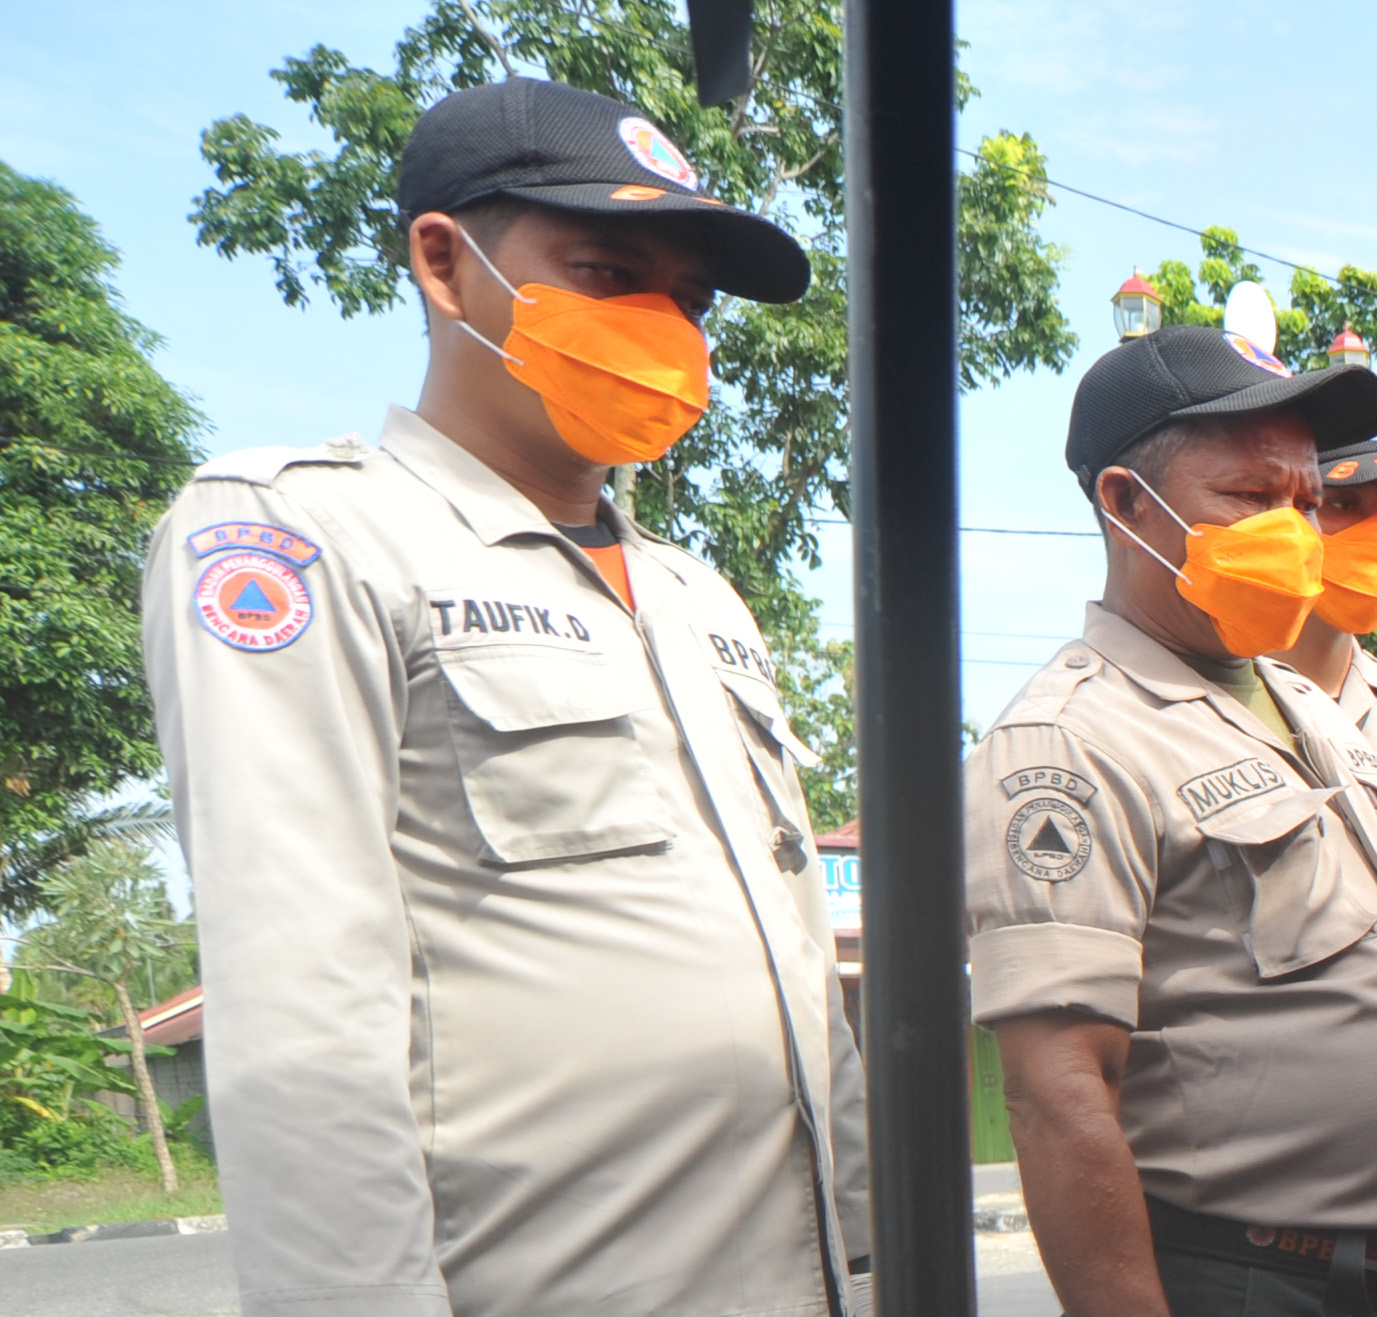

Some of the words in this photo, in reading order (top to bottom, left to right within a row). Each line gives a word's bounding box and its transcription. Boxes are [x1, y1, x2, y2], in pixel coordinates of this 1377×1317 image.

[214, 527, 295, 550] BPBD
[263, 608, 309, 646] DAERAH
[1018, 771, 1078, 791] BPBD
[1186, 761, 1278, 813] MUKLIS
